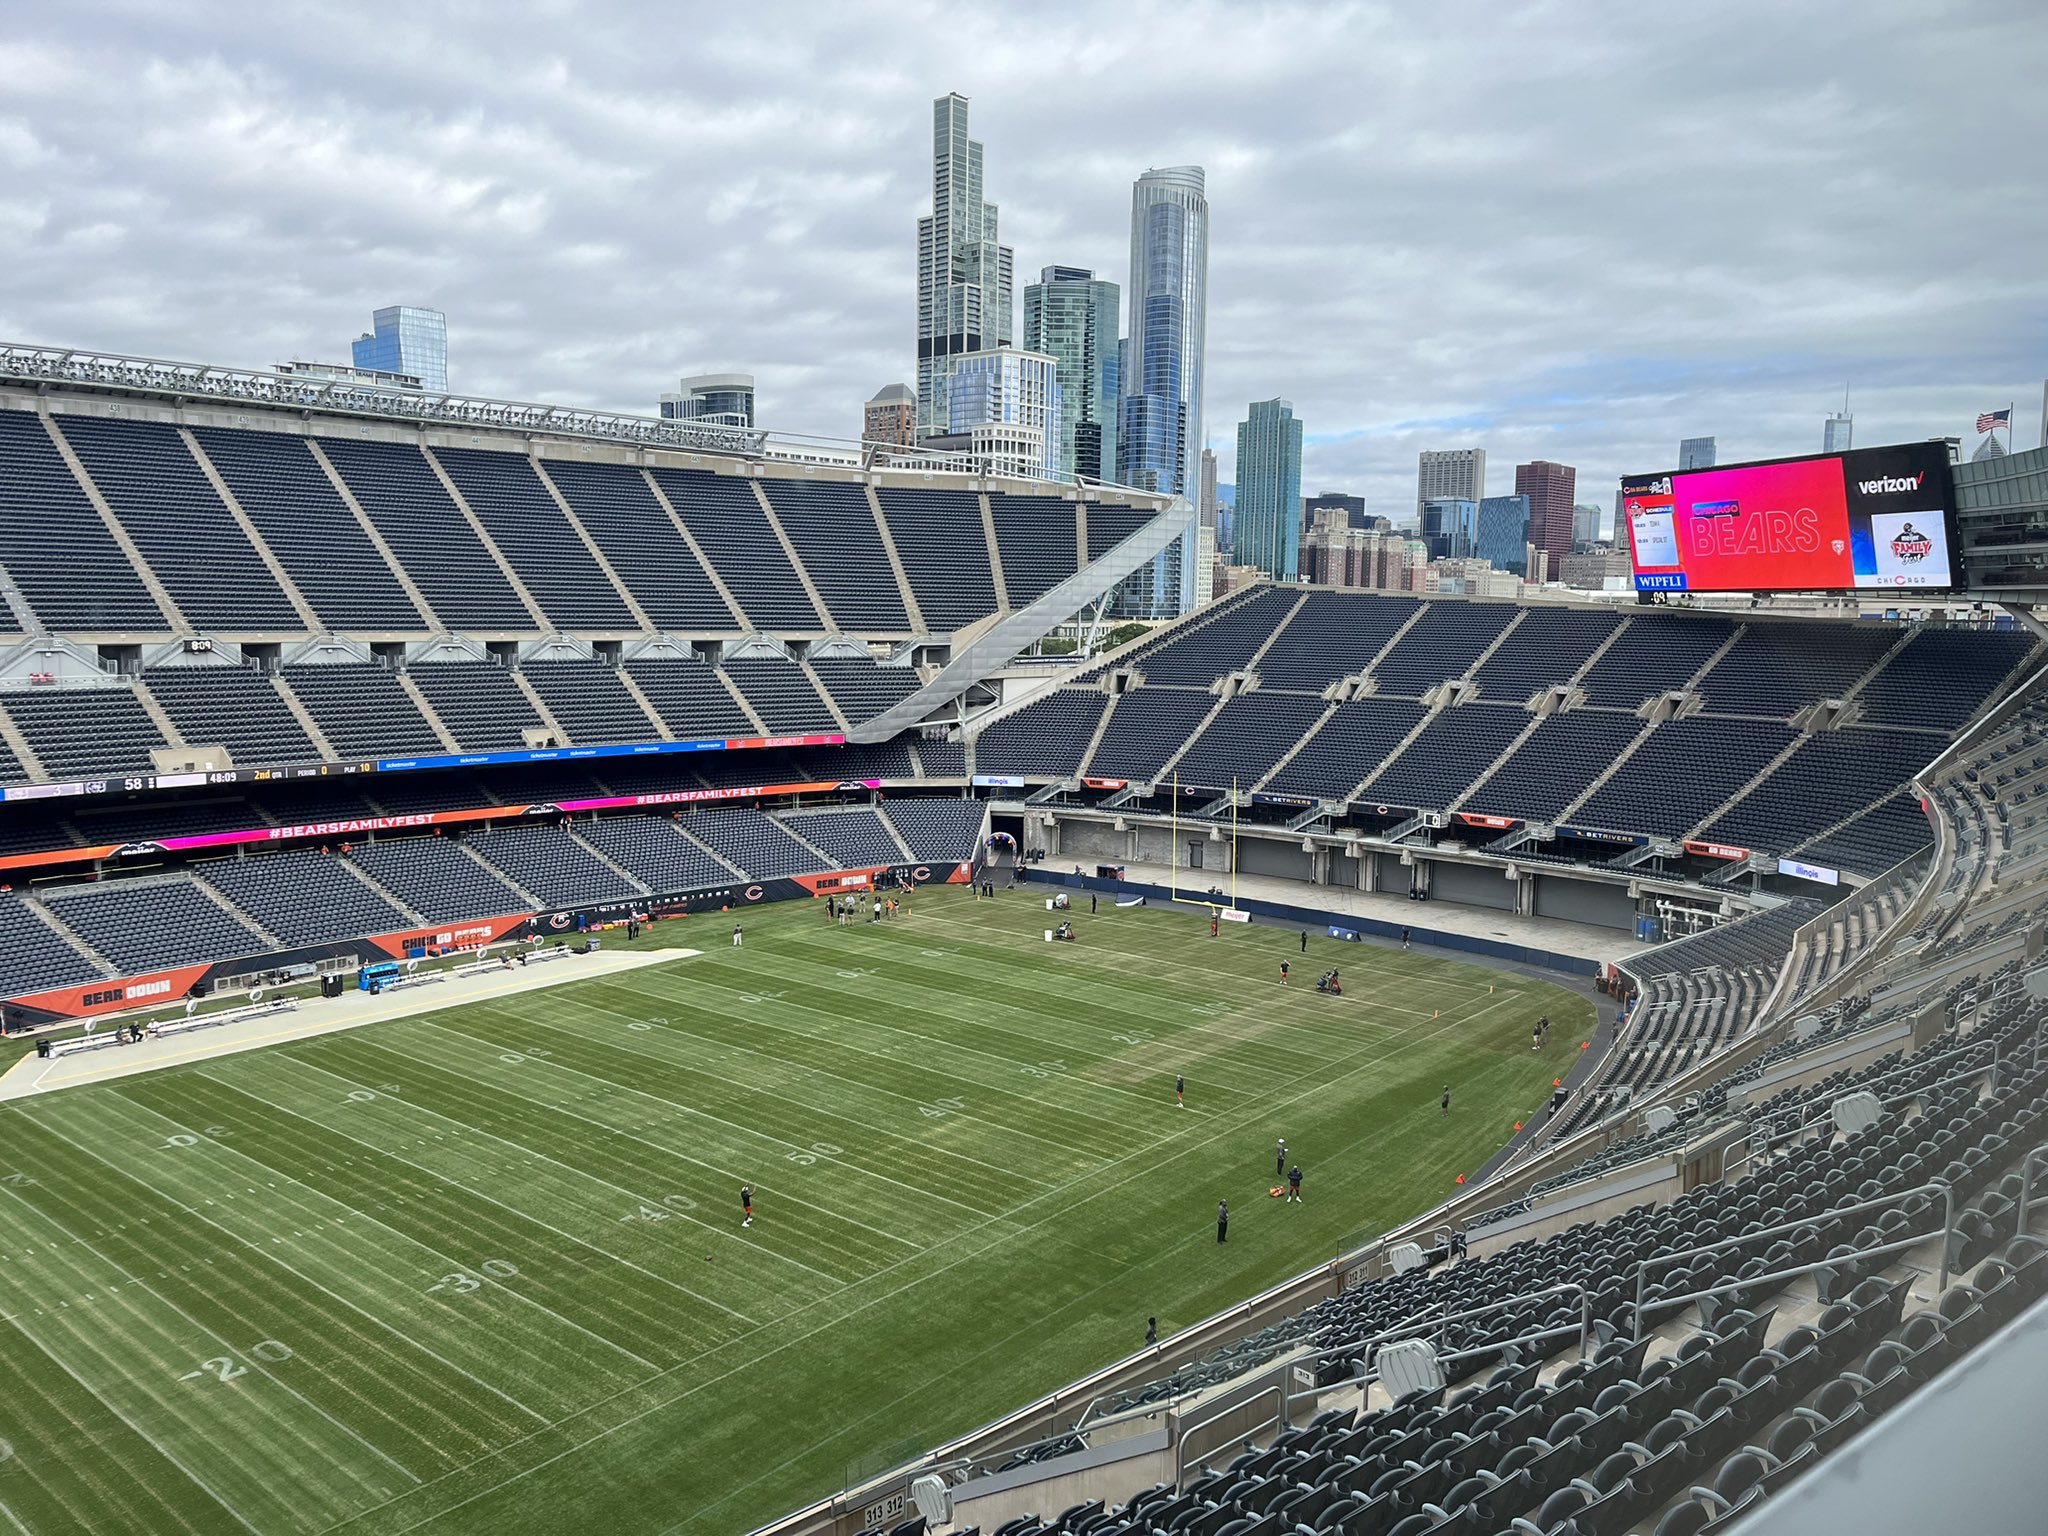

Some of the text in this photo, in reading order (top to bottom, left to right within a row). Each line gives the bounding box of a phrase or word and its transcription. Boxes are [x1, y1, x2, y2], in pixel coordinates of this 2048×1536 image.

[1859, 476, 1917, 494] verizon
[1692, 504, 1738, 515] CHICAGO
[1690, 508, 1820, 556] BEARS
[1892, 541, 1931, 556] FAMILY
[1639, 576, 1681, 586] WIPFLI
[1877, 575, 1926, 585] CHICAGO
[191, 640, 211, 651] 8:09
[209, 772, 237, 783] 48:09
[254, 770, 271, 780] 2nd
[297, 768, 316, 777] PERIOD
[321, 766, 328, 775] 0
[360, 763, 370, 772] 10
[124, 778, 143, 791] 58
[636, 787, 764, 805] #BEARSFAMILYFEST
[1272, 796, 1312, 806] BETRIVERS
[269, 813, 435, 839] #BEARSFAMILYFEST
[1585, 831, 1634, 843] BETRIVERS
[816, 874, 867, 889] BEAR DOWN
[402, 932, 451, 950] CHICAGO
[83, 979, 171, 1007] BEAR DOWN
[785, 1141, 845, 1166] 50
[440, 1258, 519, 1294] 30
[201, 1339, 295, 1383] 20
[866, 1495, 903, 1525] 313 312
